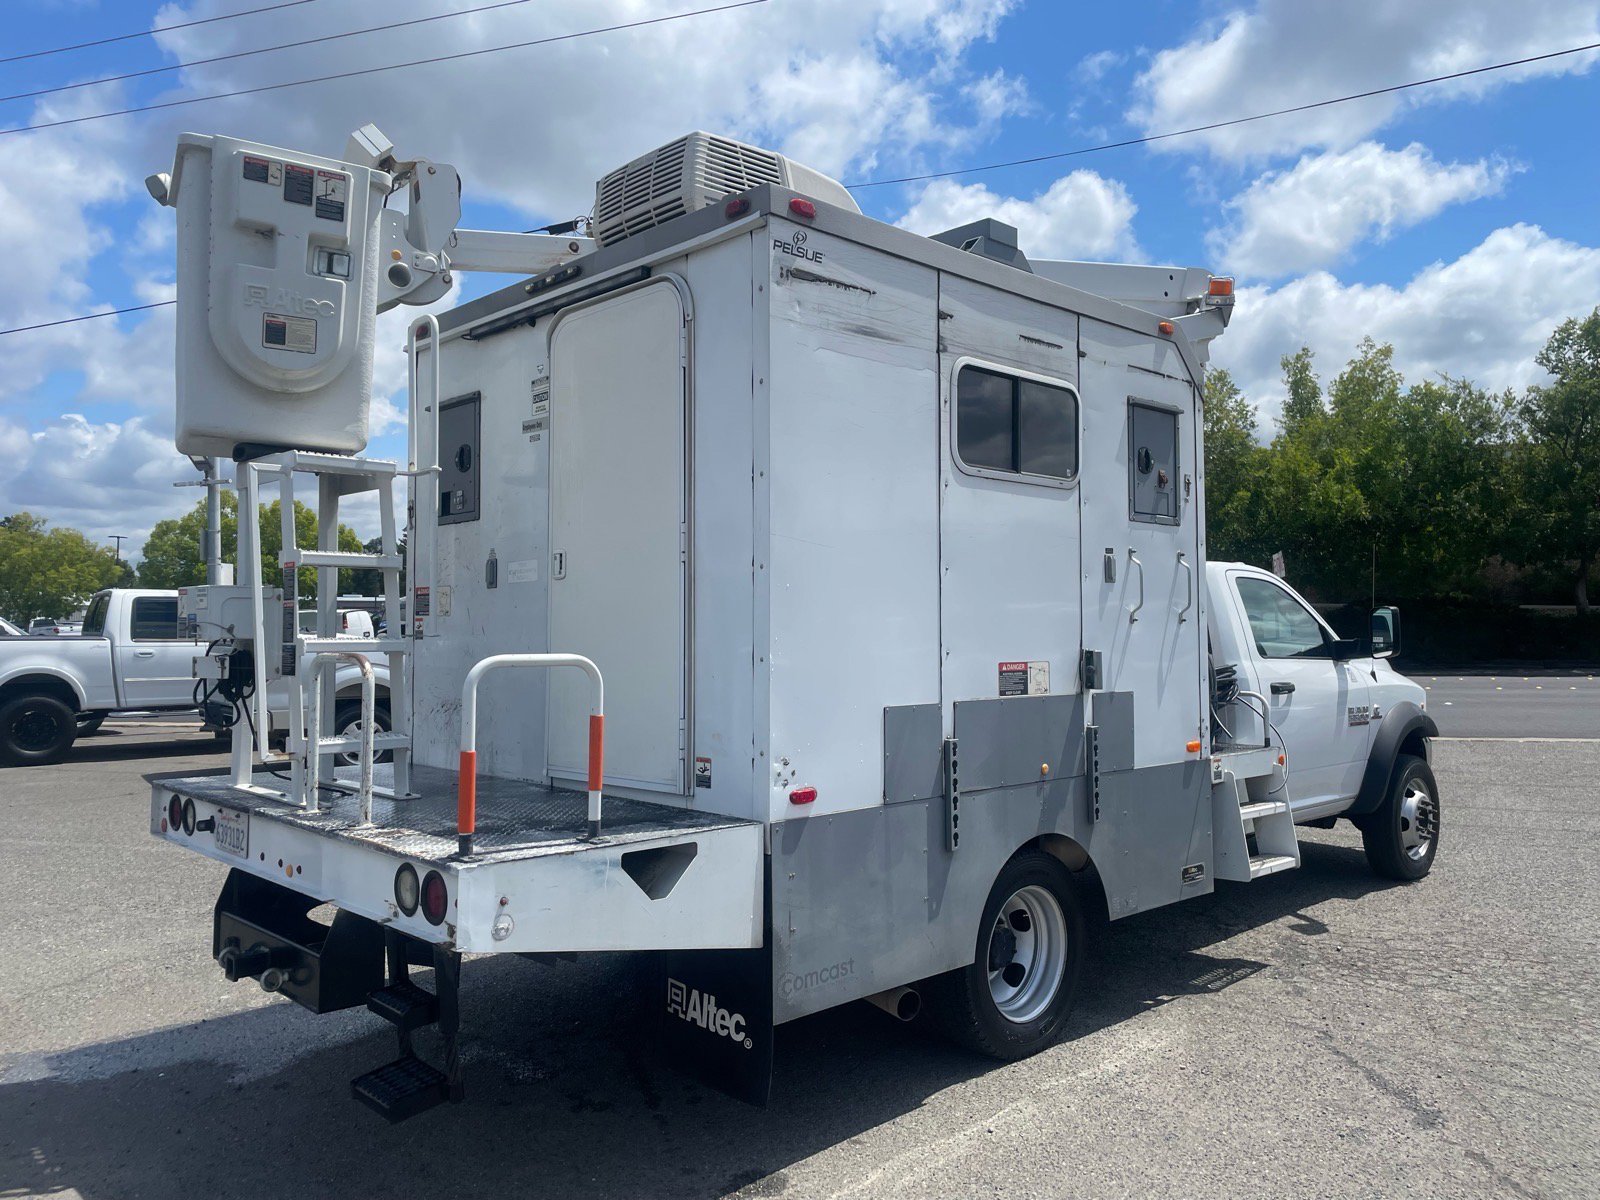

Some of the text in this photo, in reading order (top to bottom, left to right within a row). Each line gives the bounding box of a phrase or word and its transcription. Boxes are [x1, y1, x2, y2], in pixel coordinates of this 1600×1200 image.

[773, 239, 824, 264] PELSUE
[274, 287, 335, 318] Altec
[533, 393, 549, 403] CAUTION
[216, 823, 245, 851] 63931B2
[780, 957, 856, 997] Comcast
[686, 988, 746, 1042] Altec
